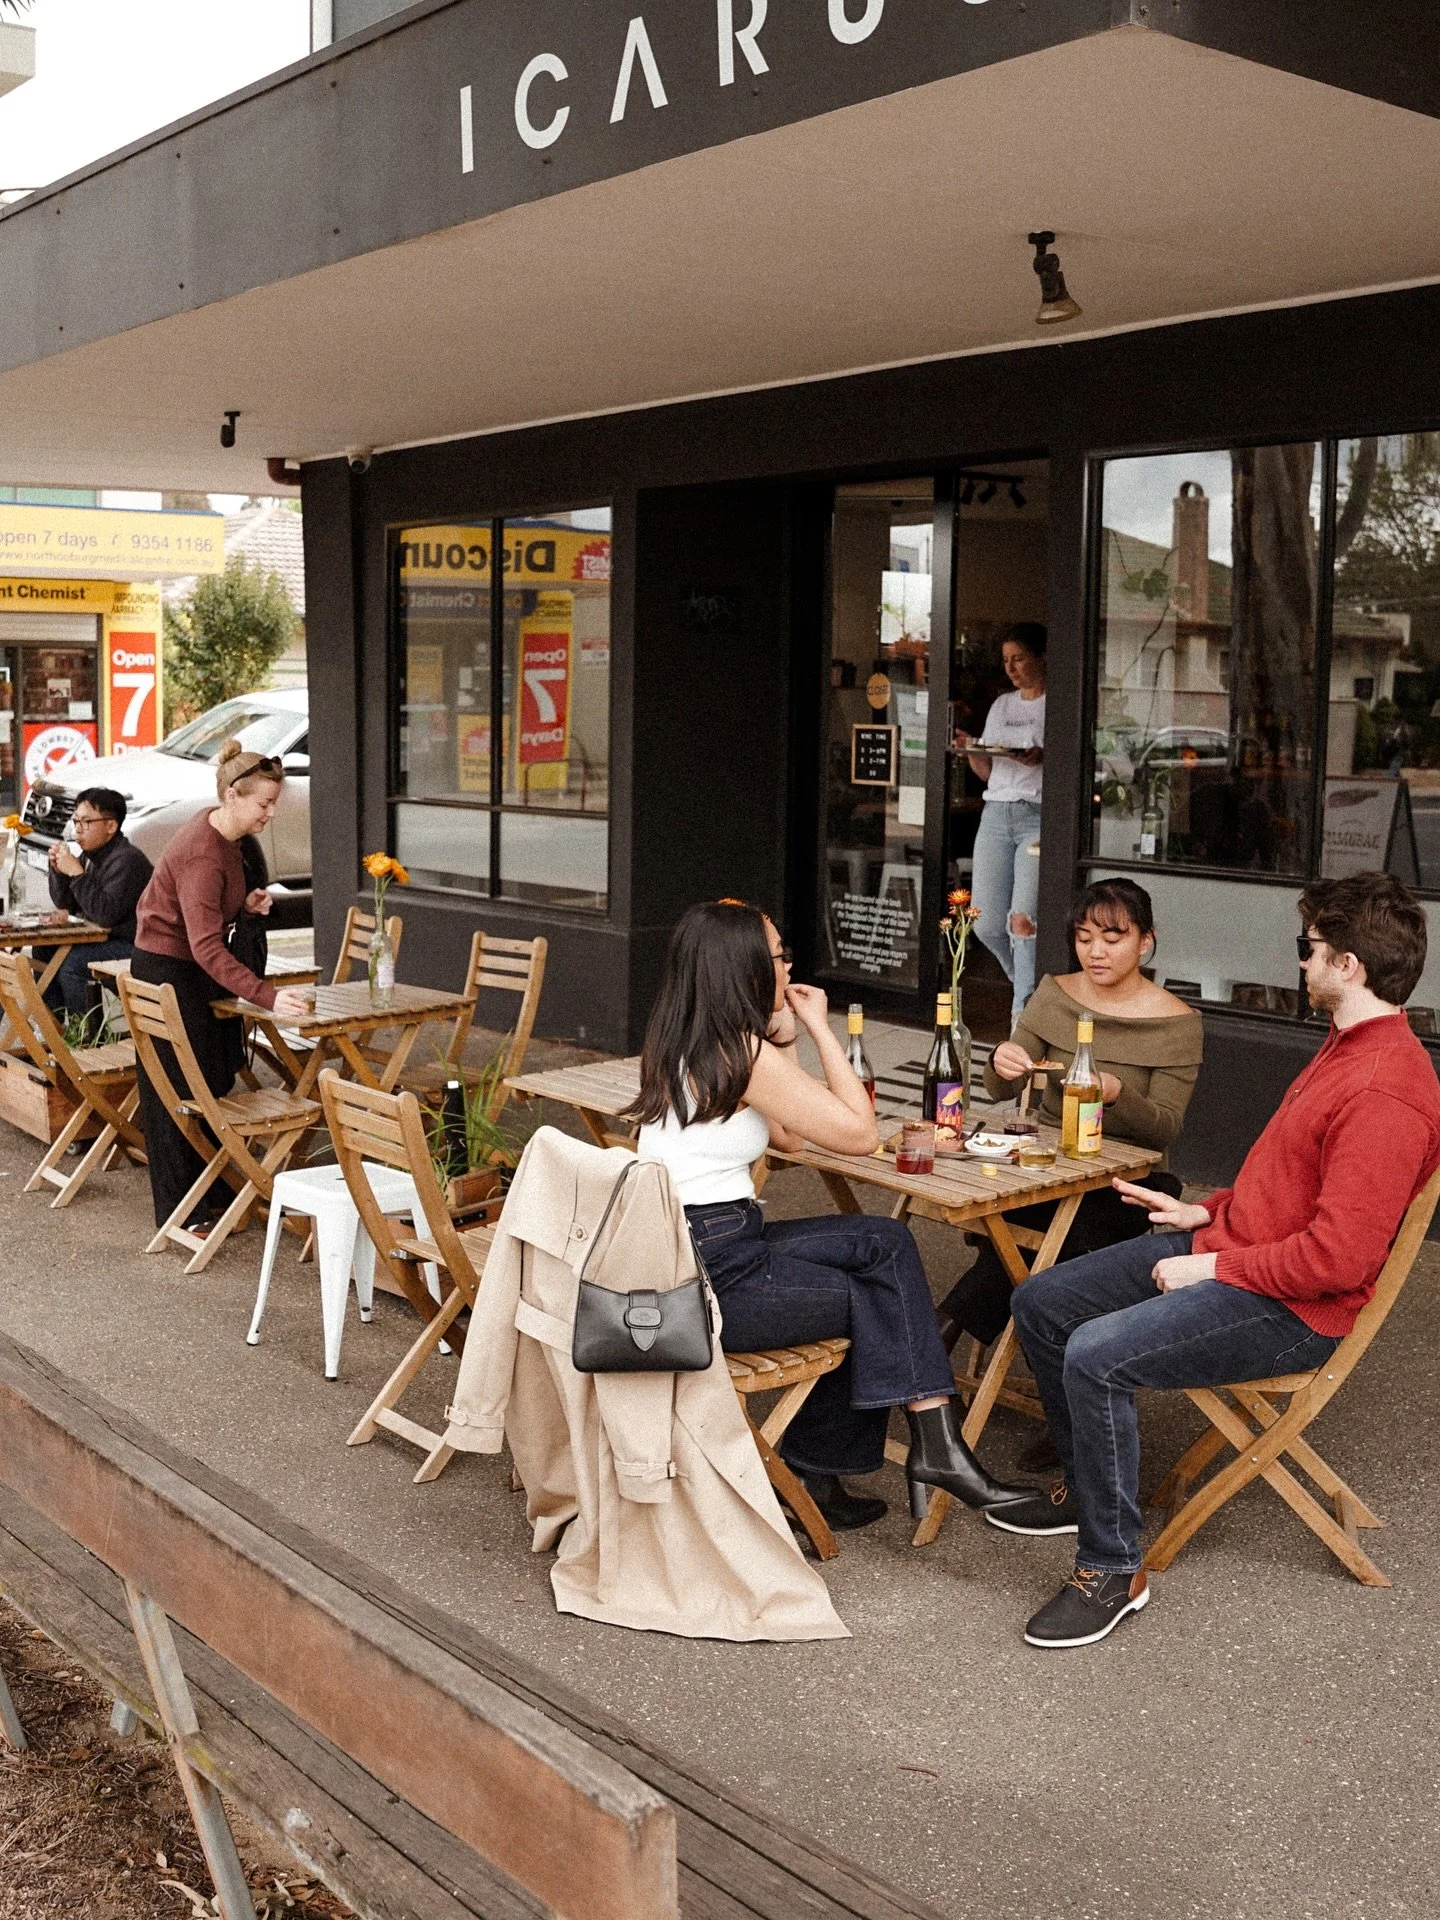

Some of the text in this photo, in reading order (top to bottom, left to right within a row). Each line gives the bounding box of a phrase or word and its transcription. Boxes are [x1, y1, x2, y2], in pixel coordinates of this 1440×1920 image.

[44, 530, 52, 545] 7
[58, 532, 98, 550] days
[131, 534, 170, 550] 9354
[176, 536, 213, 553] 1186
[17, 584, 86, 600] Chemist
[112, 649, 155, 669] Open
[112, 672, 155, 737] 7
